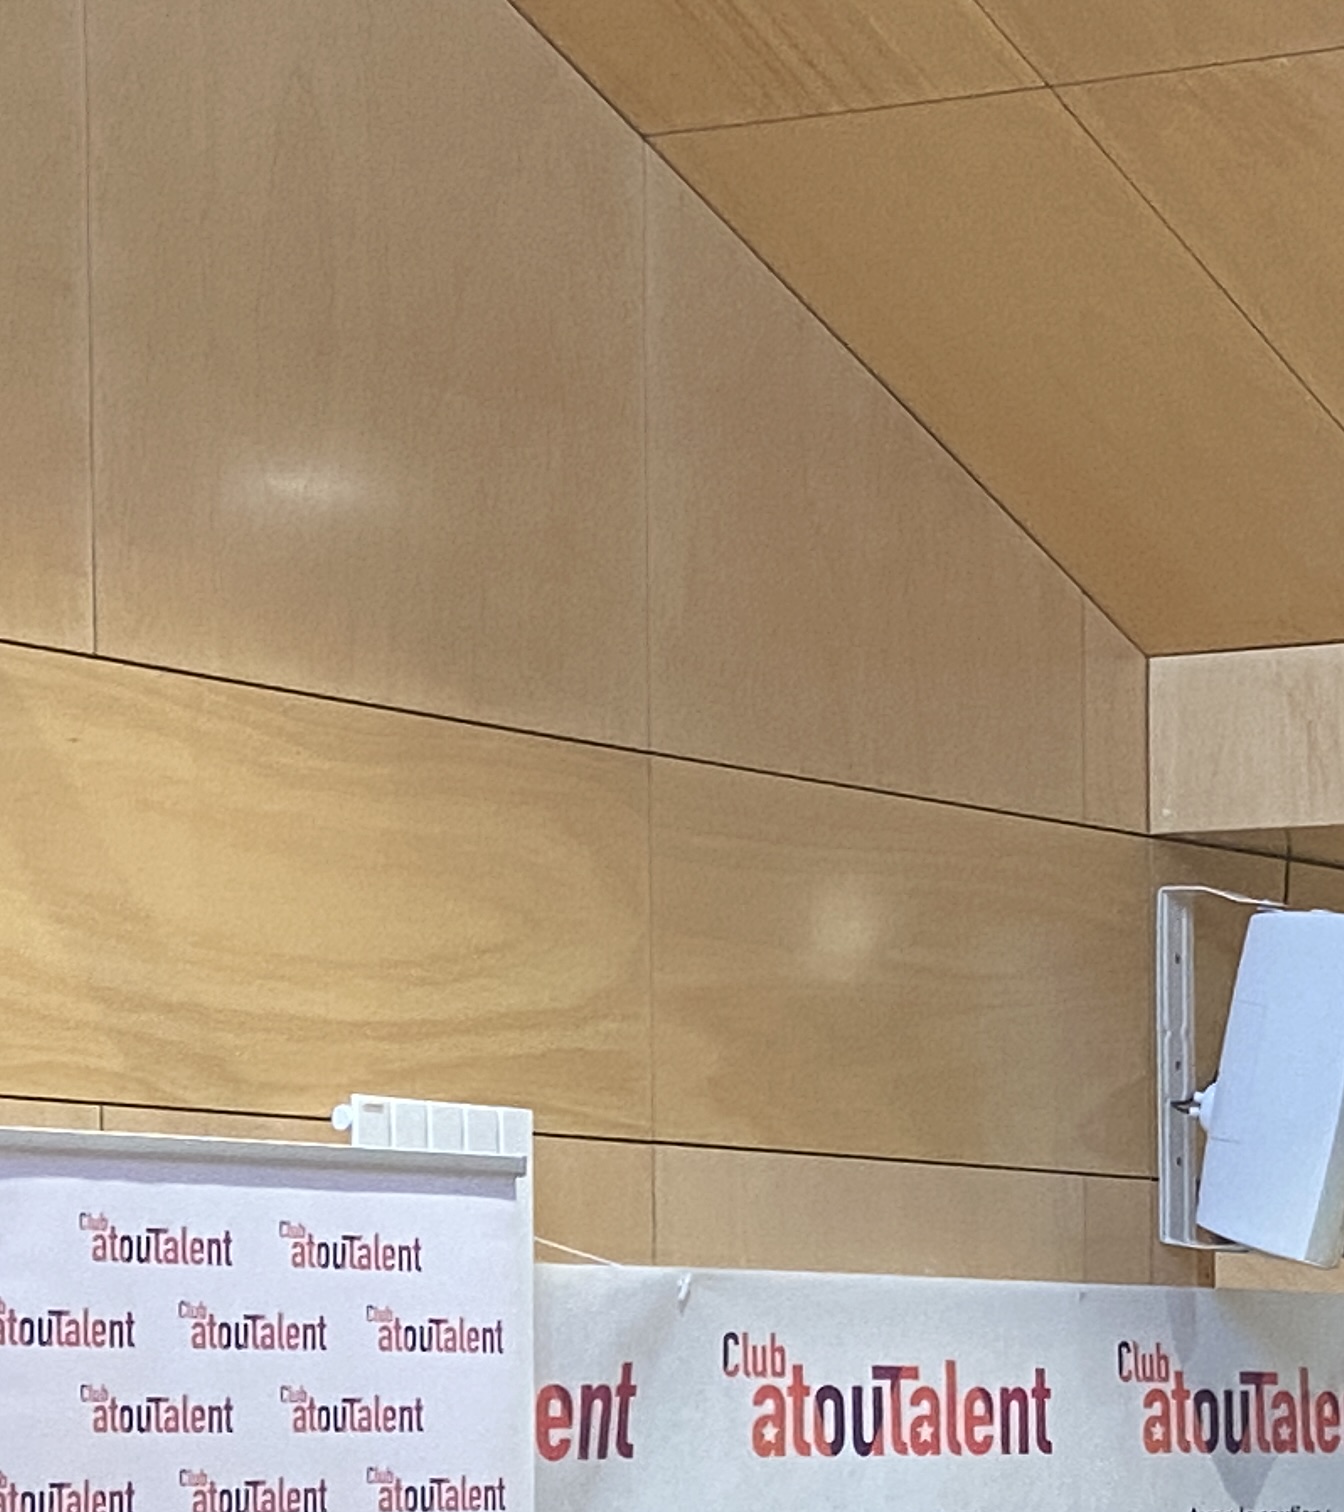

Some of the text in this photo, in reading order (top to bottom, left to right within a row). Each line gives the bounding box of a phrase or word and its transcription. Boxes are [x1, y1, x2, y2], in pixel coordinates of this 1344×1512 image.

[80, 1213, 108, 1229] Club
[280, 1221, 306, 1237] Club
[93, 1227, 232, 1266] atouTalent
[292, 1233, 421, 1272] atouTalent
[179, 1301, 206, 1317] Club
[367, 1305, 392, 1321] Club
[192, 1312, 326, 1350] atouTalent
[379, 1317, 503, 1353] atouTalent
[723, 1332, 786, 1378] Club
[1117, 1341, 1169, 1382] Club
[81, 1385, 109, 1401] Club
[281, 1386, 307, 1402] Club
[752, 1360, 1053, 1457] atouTalent
[94, 1395, 233, 1433] atouTalent
[293, 1395, 423, 1432] atouTalent
[180, 1470, 207, 1486] Club
[367, 1467, 393, 1483] Club
[379, 1476, 505, 1512] atouTalent
